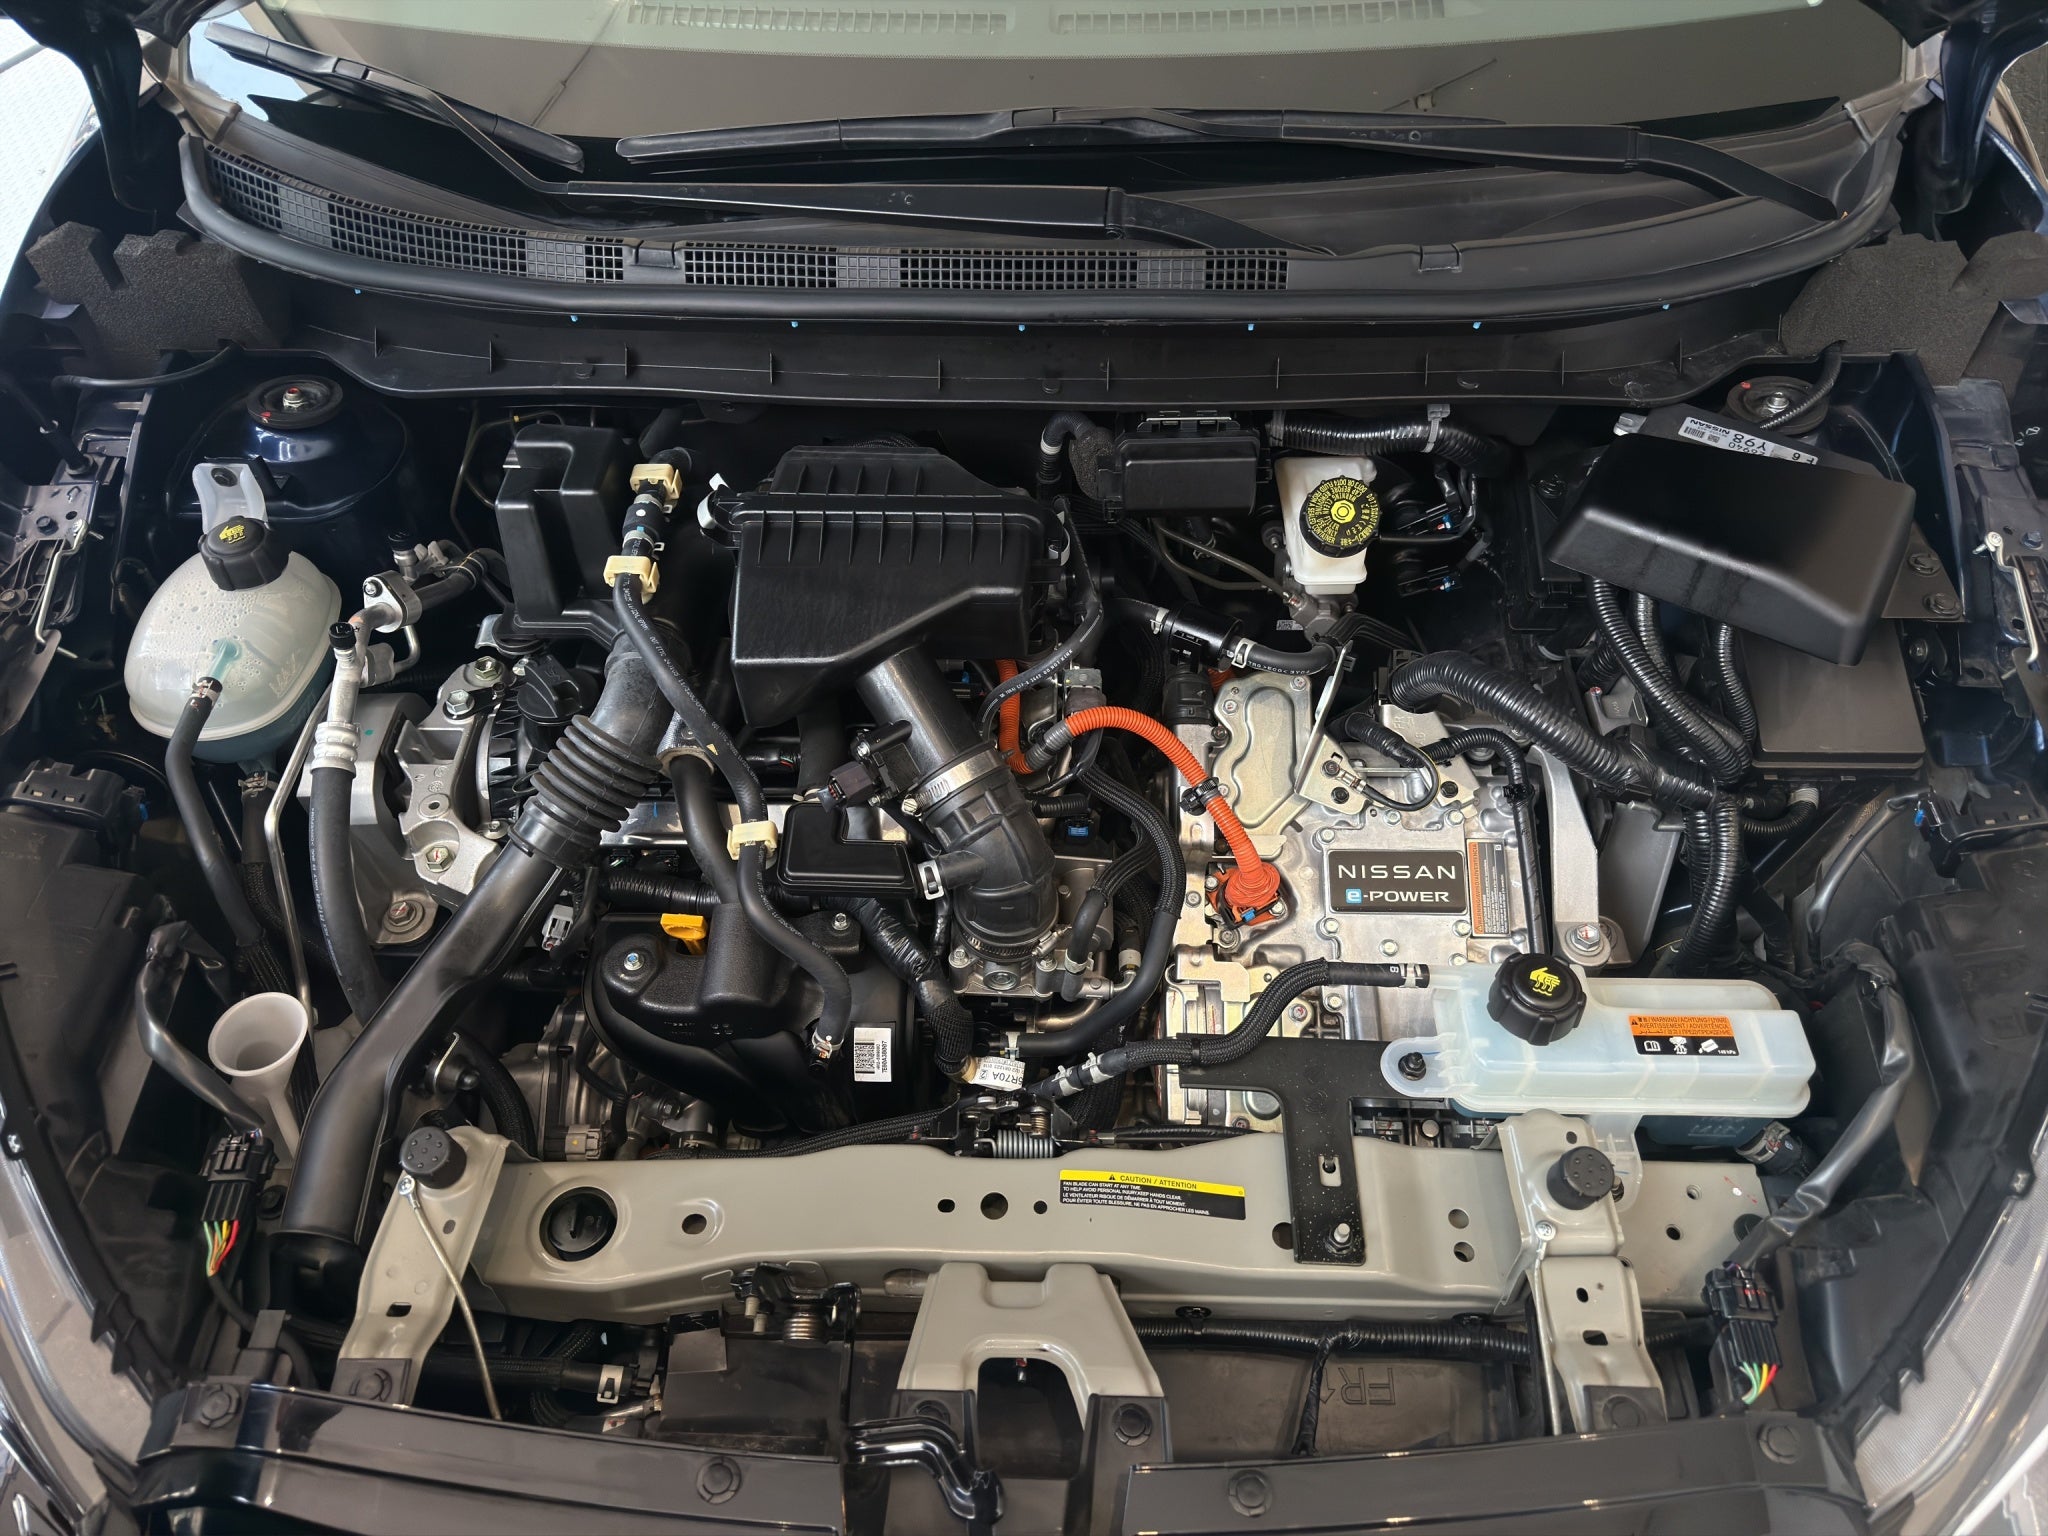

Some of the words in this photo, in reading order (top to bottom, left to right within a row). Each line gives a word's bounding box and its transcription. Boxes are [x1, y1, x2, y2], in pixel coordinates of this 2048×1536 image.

[1690, 419, 1729, 434] NISSAN
[1732, 432, 1767, 451] Y98
[1338, 865, 1456, 880] NISSAN
[1346, 889, 1450, 903] e-POWER
[1120, 1175, 1152, 1184] CAUTION
[1159, 1179, 1197, 1190] ATTENTION
[1338, 1367, 1396, 1405] FR
